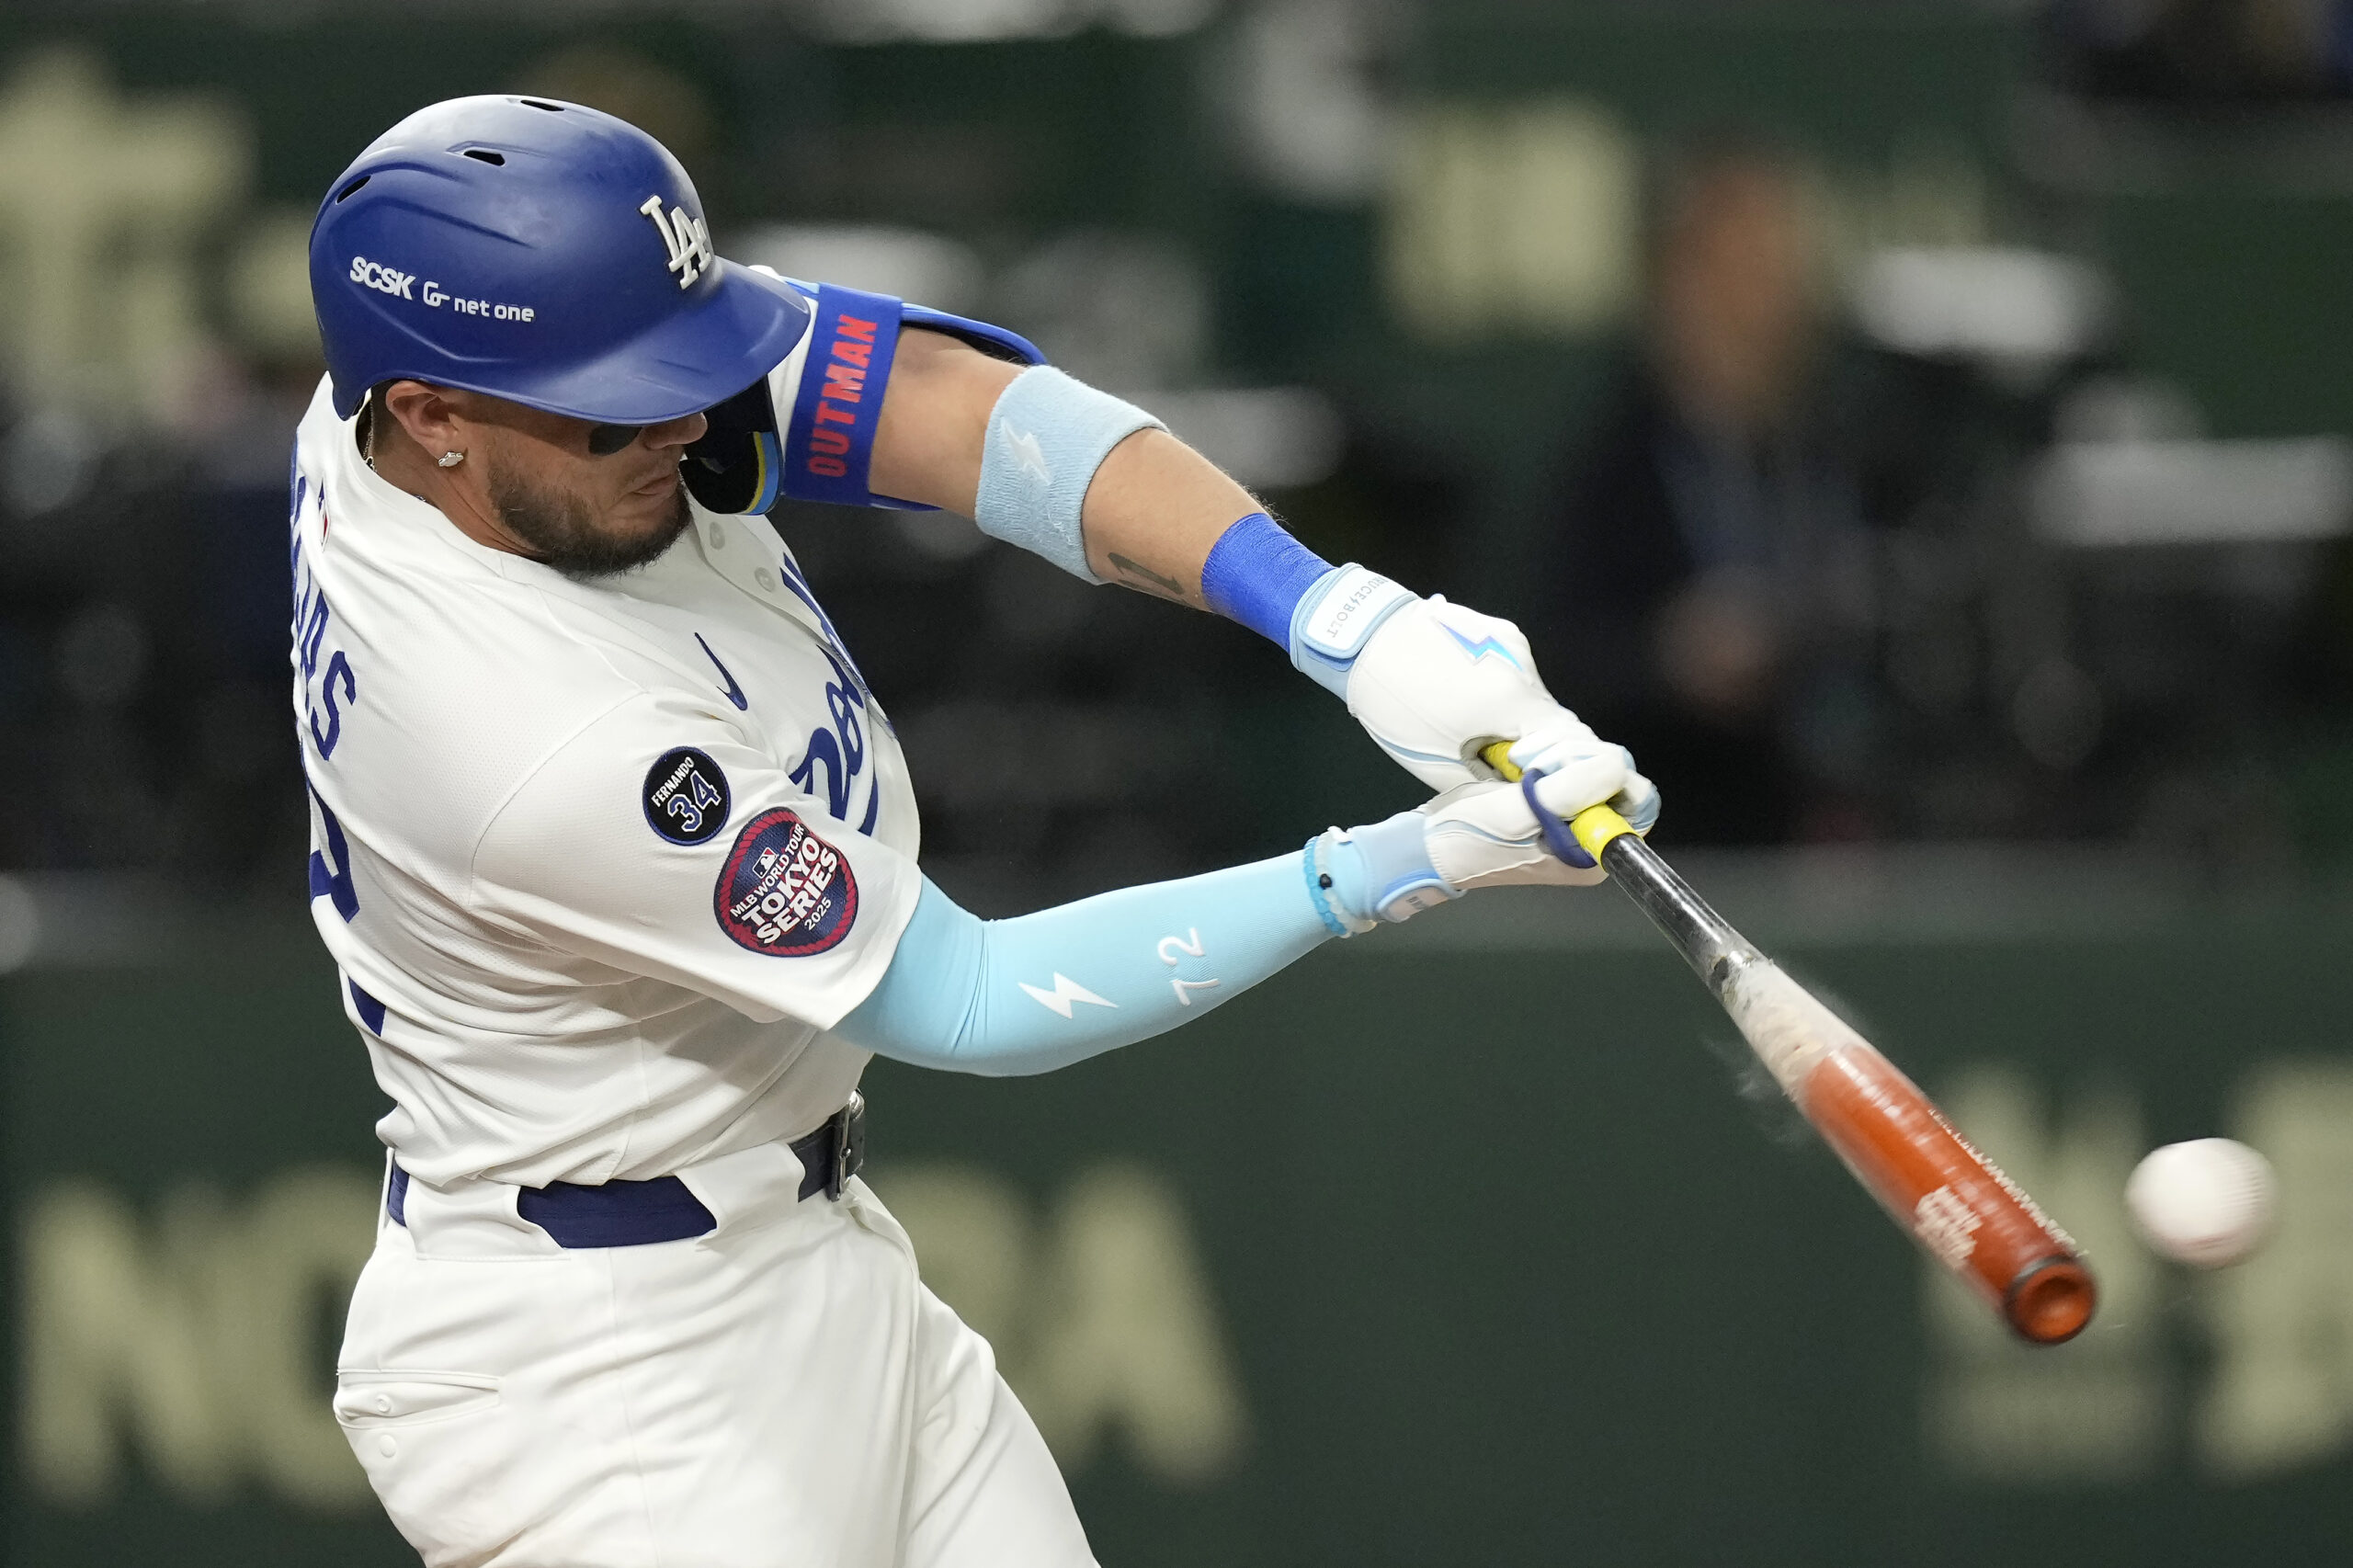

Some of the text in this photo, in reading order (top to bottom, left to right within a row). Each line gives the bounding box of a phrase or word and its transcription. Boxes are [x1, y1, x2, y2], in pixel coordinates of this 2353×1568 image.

[349, 256, 416, 301] SCSK
[640, 195, 712, 290] LA
[454, 297, 535, 323] net one
[807, 313, 878, 478] OUTMAN
[651, 756, 695, 808] FERNANDO
[667, 769, 722, 833] 34
[730, 824, 805, 917] MLB WORLD TOUR
[741, 836, 820, 927] TOKYO
[756, 846, 838, 944] SERIES
[804, 896, 832, 930] 2025
[1157, 927, 1221, 1006] 72
